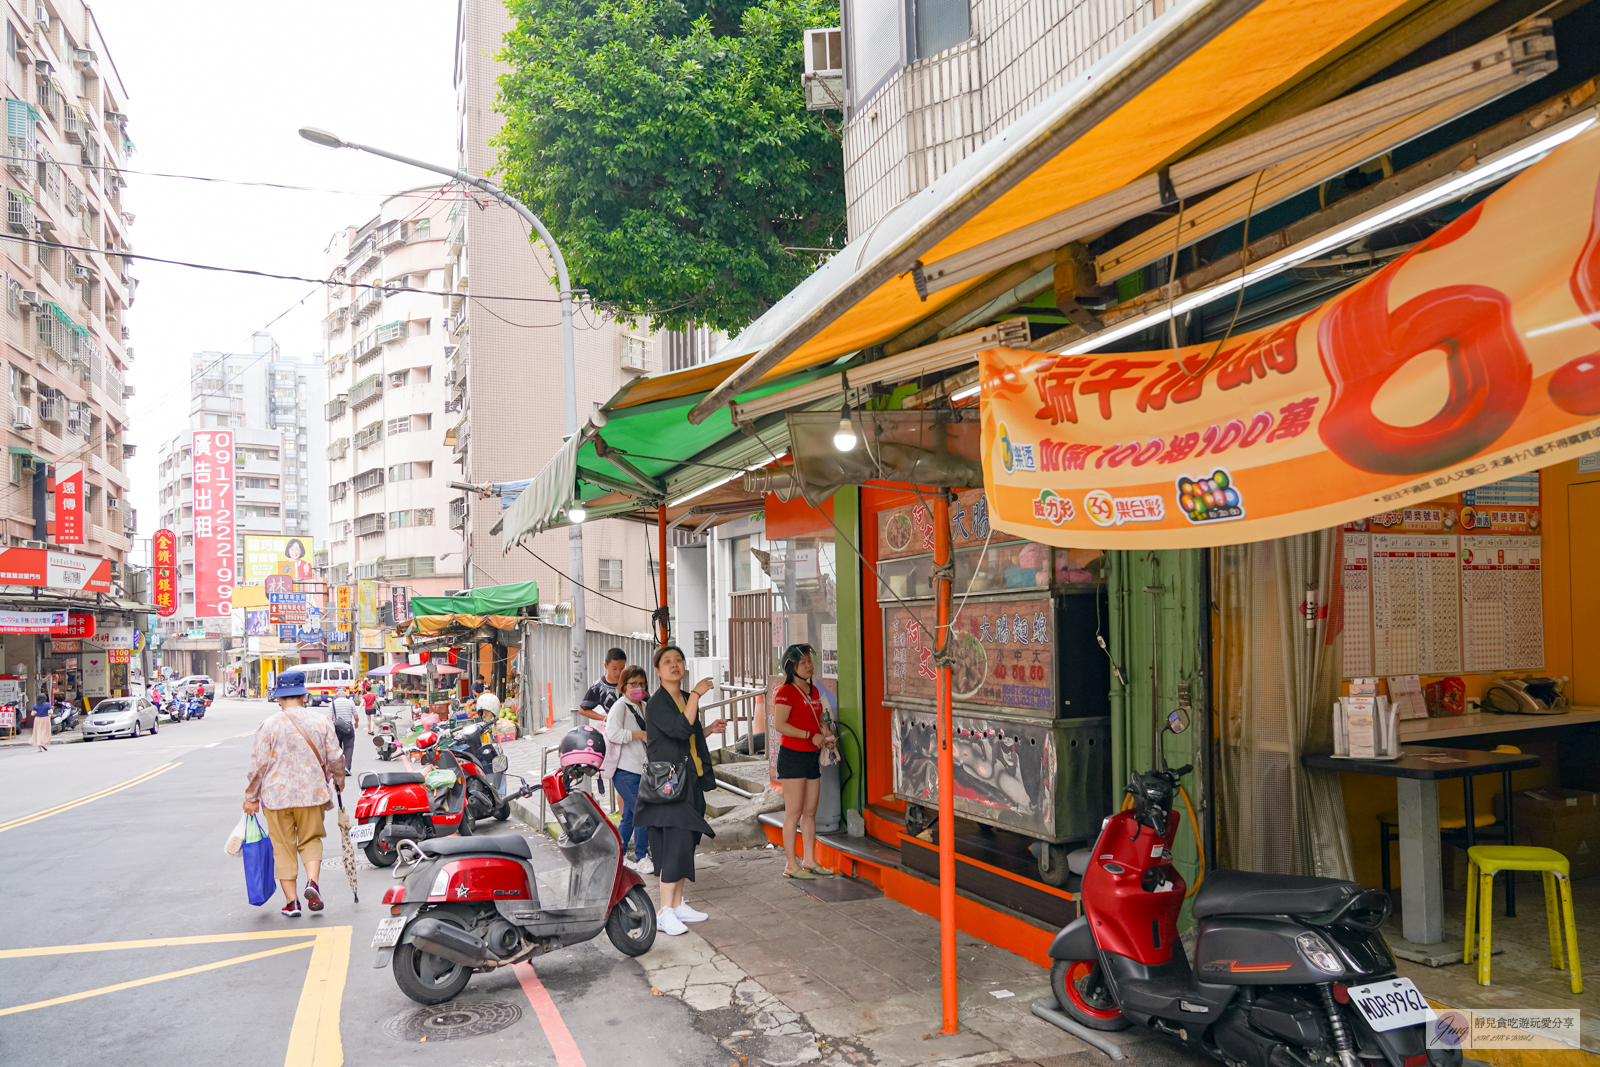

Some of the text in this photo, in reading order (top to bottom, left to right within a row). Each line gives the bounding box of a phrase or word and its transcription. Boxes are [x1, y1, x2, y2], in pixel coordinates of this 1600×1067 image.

[1039, 397, 1319, 472] 加開100組100萬
[62, 482, 76, 511] 遠傳
[194, 433, 213, 539] 廣告出租
[215, 433, 233, 615] 0917-222-990
[952, 495, 998, 541] 大腸
[1033, 498, 1074, 525] 威力彩
[1404, 510, 1441, 522] 開獎號碼
[1491, 512, 1526, 523] 開獎號碼
[269, 577, 287, 593] 林
[979, 612, 1049, 645] 大腸麵線
[1014, 649, 1022, 662] 中
[1032, 650, 1040, 663] 大
[994, 664, 1007, 679] 40
[1012, 665, 1025, 680] 50
